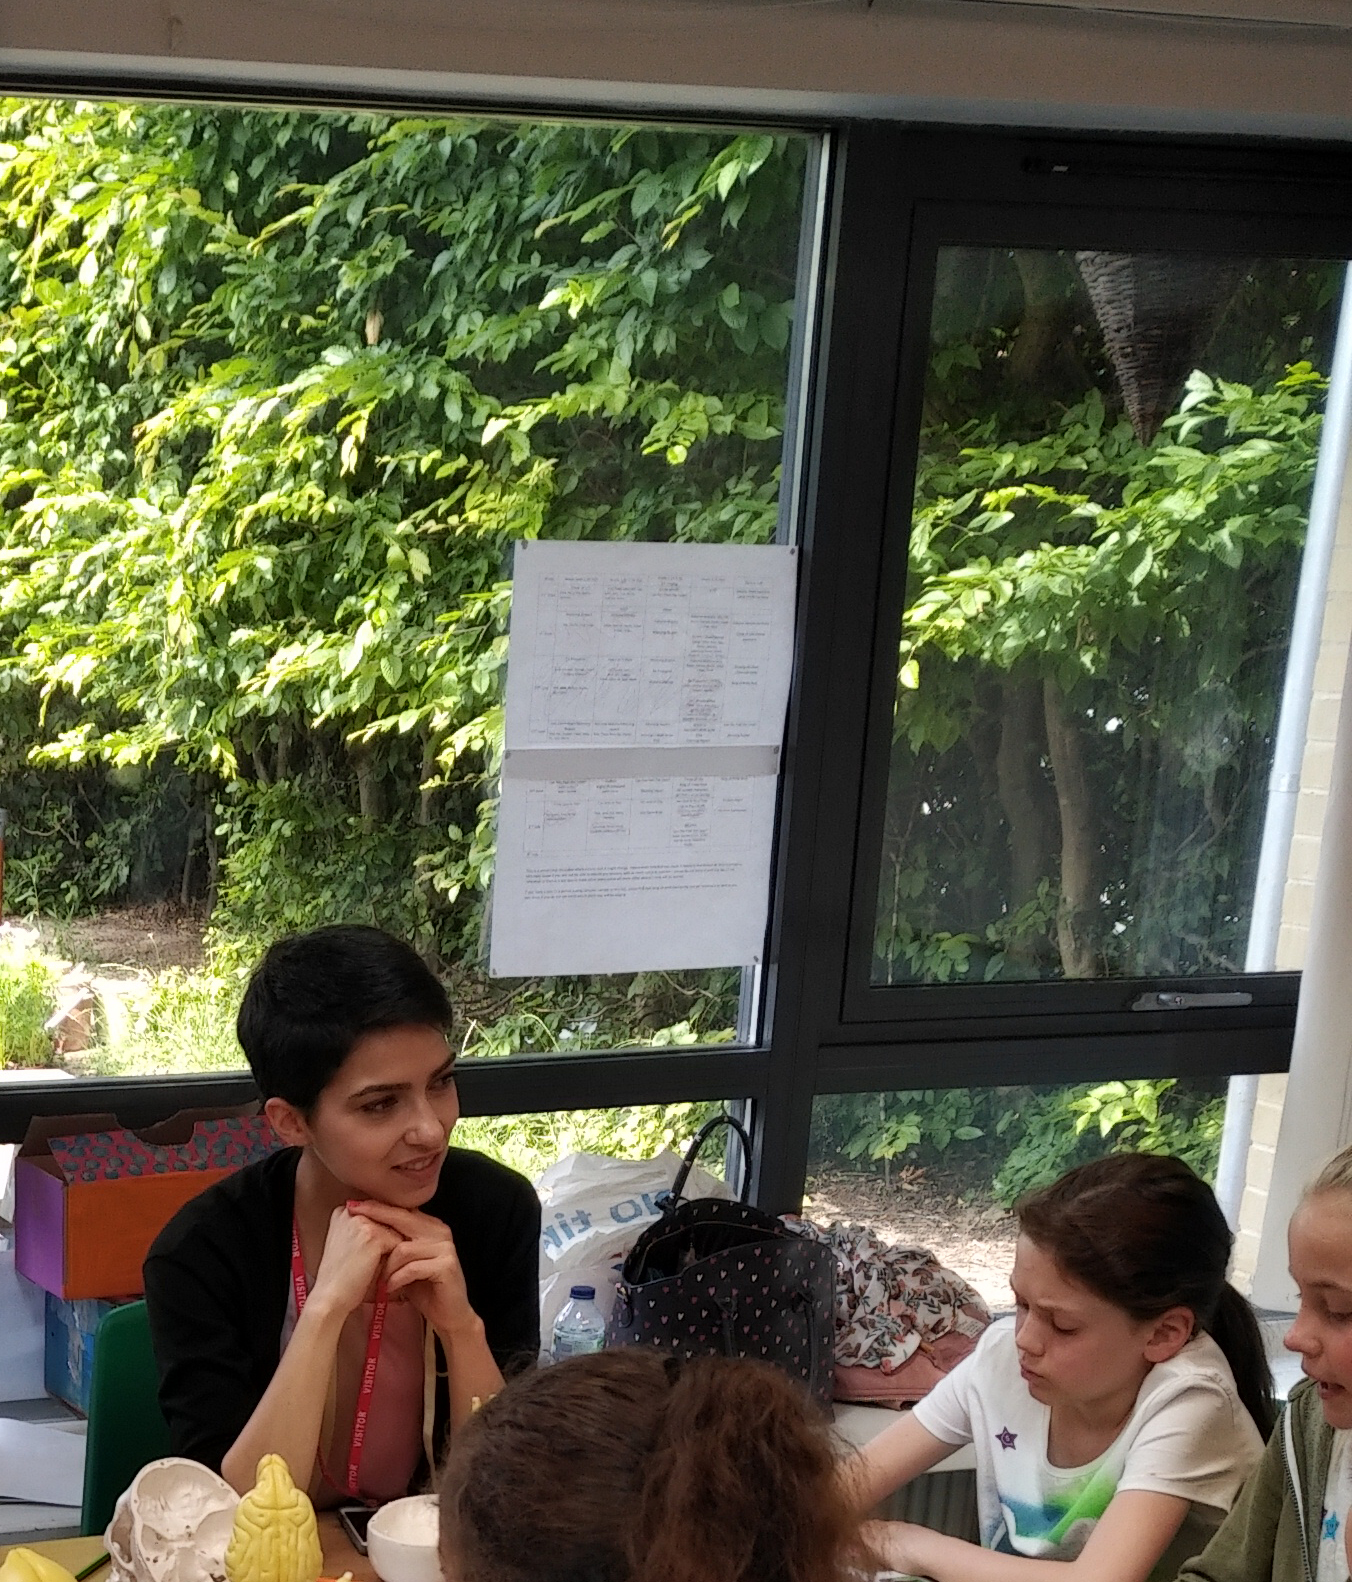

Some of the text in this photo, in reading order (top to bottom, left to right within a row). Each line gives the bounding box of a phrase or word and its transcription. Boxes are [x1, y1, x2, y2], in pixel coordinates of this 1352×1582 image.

[295, 1275, 308, 1315] VISITO
[353, 1411, 367, 1447] VISITOR
[362, 1357, 377, 1394] VISITOR
[372, 1302, 386, 1340] VISITOR
